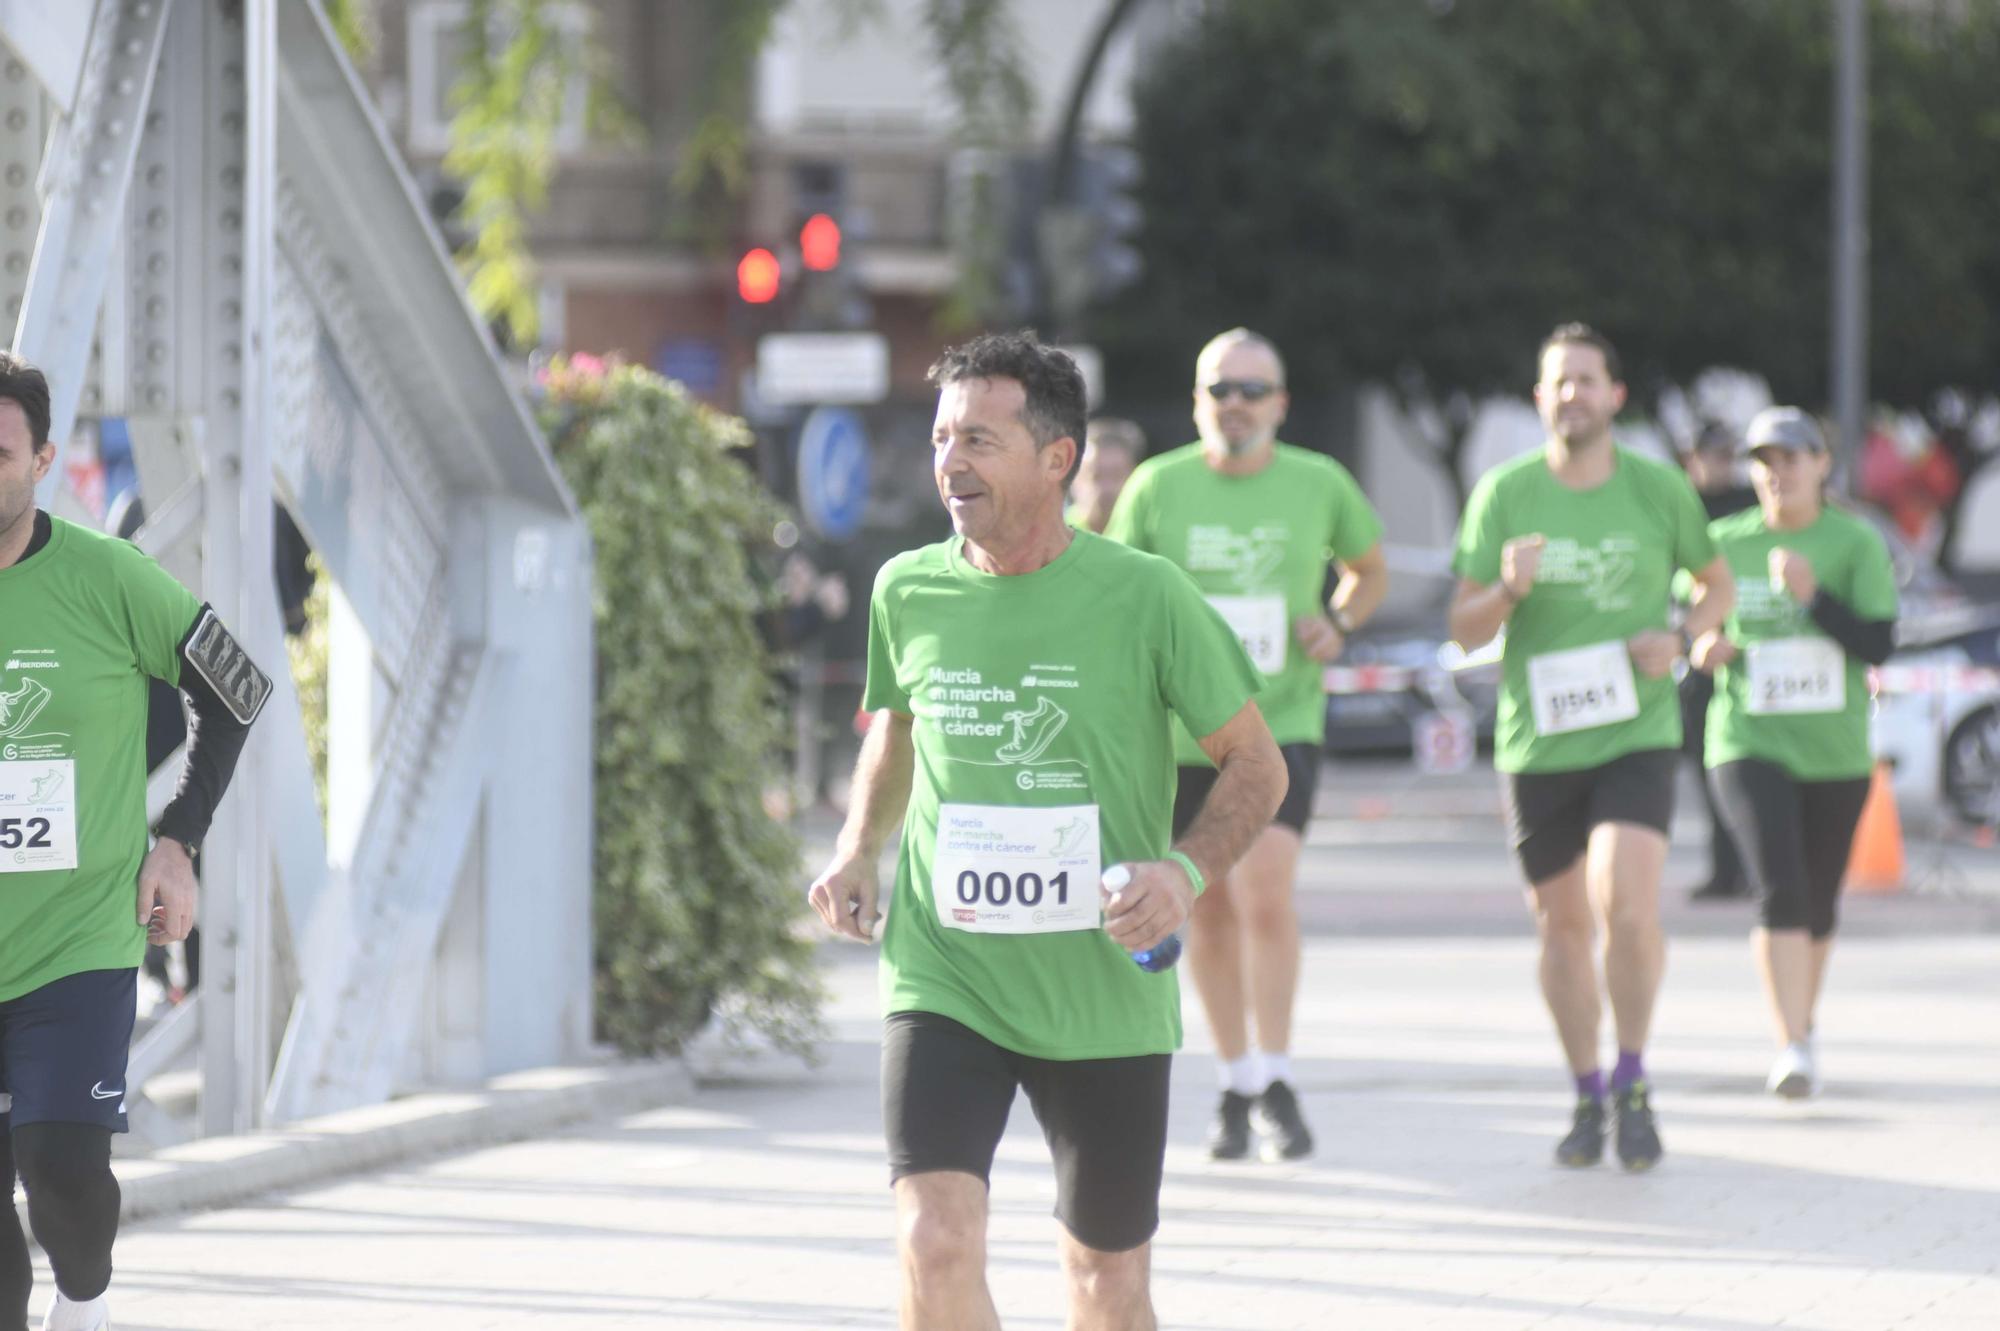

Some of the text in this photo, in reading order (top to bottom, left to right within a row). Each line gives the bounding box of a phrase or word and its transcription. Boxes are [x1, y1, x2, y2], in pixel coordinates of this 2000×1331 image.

[928, 667, 982, 685] Murcia
[950, 685, 1016, 702] marcha
[945, 720, 1005, 737] cáncer
[950, 817, 983, 828] Murcia
[0, 817, 51, 849] 52
[949, 829, 1004, 841] en marcha
[948, 840, 1037, 854] contra el cáncer
[956, 869, 1069, 907] 0001
